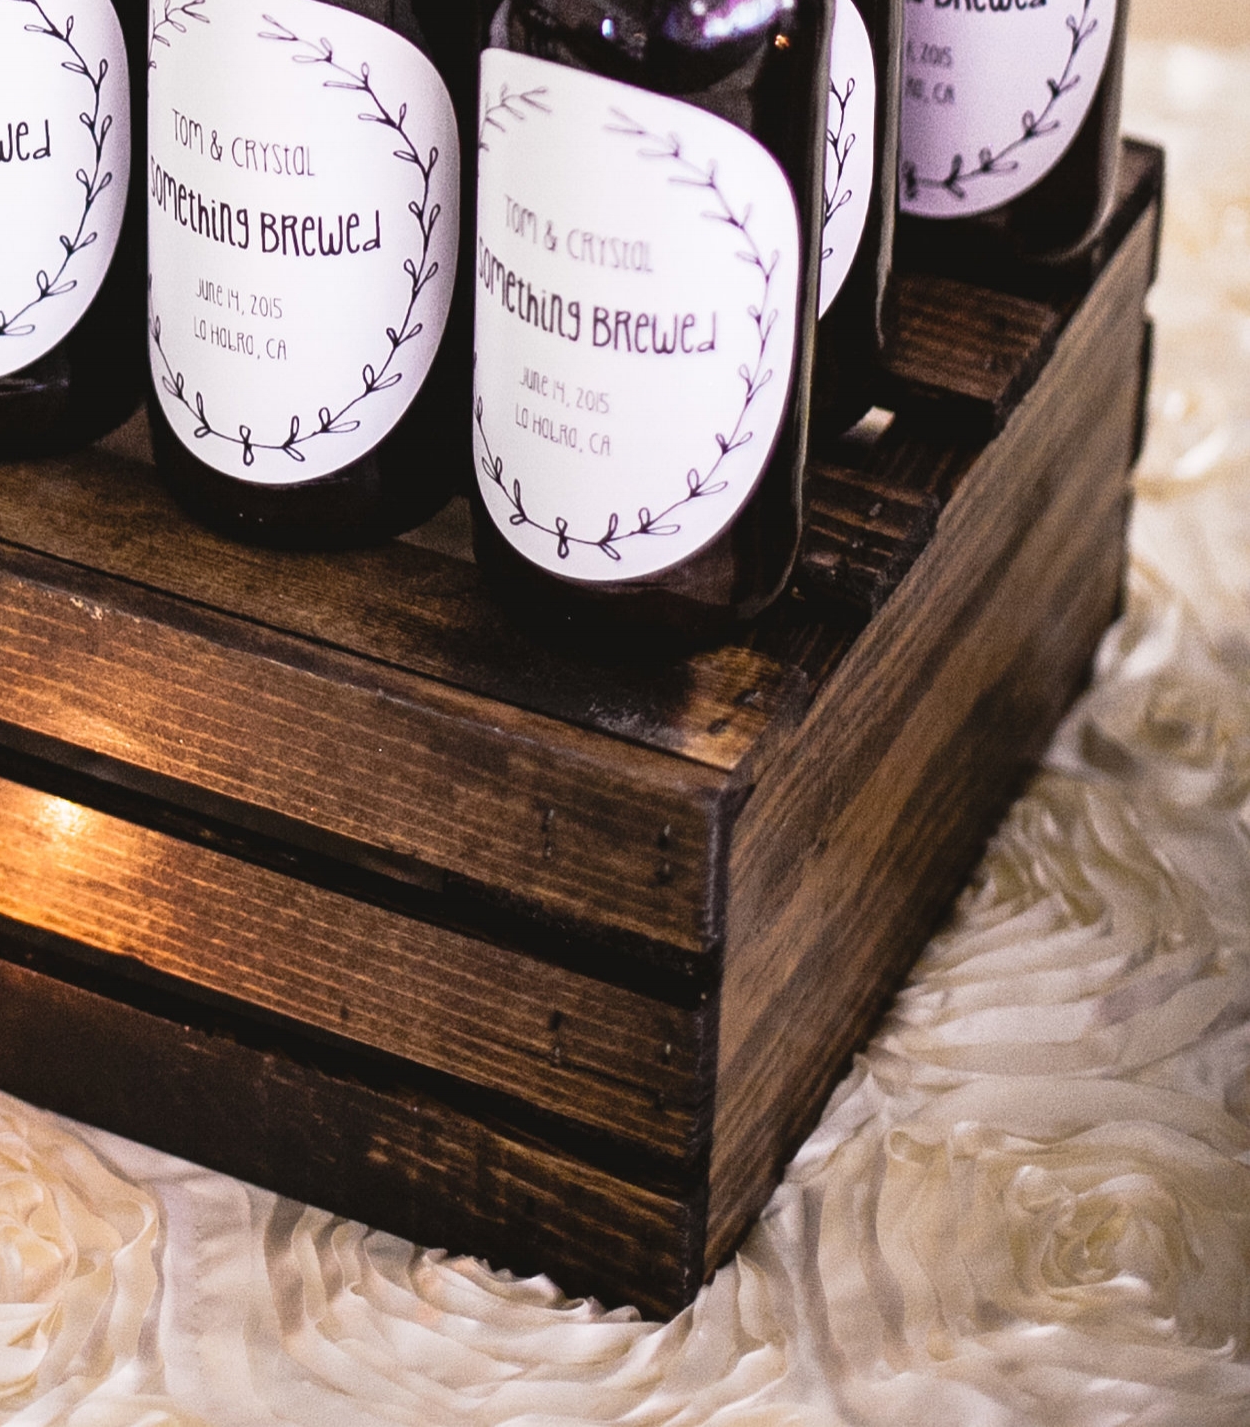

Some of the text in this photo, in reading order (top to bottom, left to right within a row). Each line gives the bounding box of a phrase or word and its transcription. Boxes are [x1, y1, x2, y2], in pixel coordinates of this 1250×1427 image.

[210, 129, 223, 162] &
[544, 219, 557, 252] &
[250, 294, 283, 320] 2015
[266, 338, 287, 361] CA
[576, 387, 610, 414] 2015
[589, 432, 610, 456] CA
